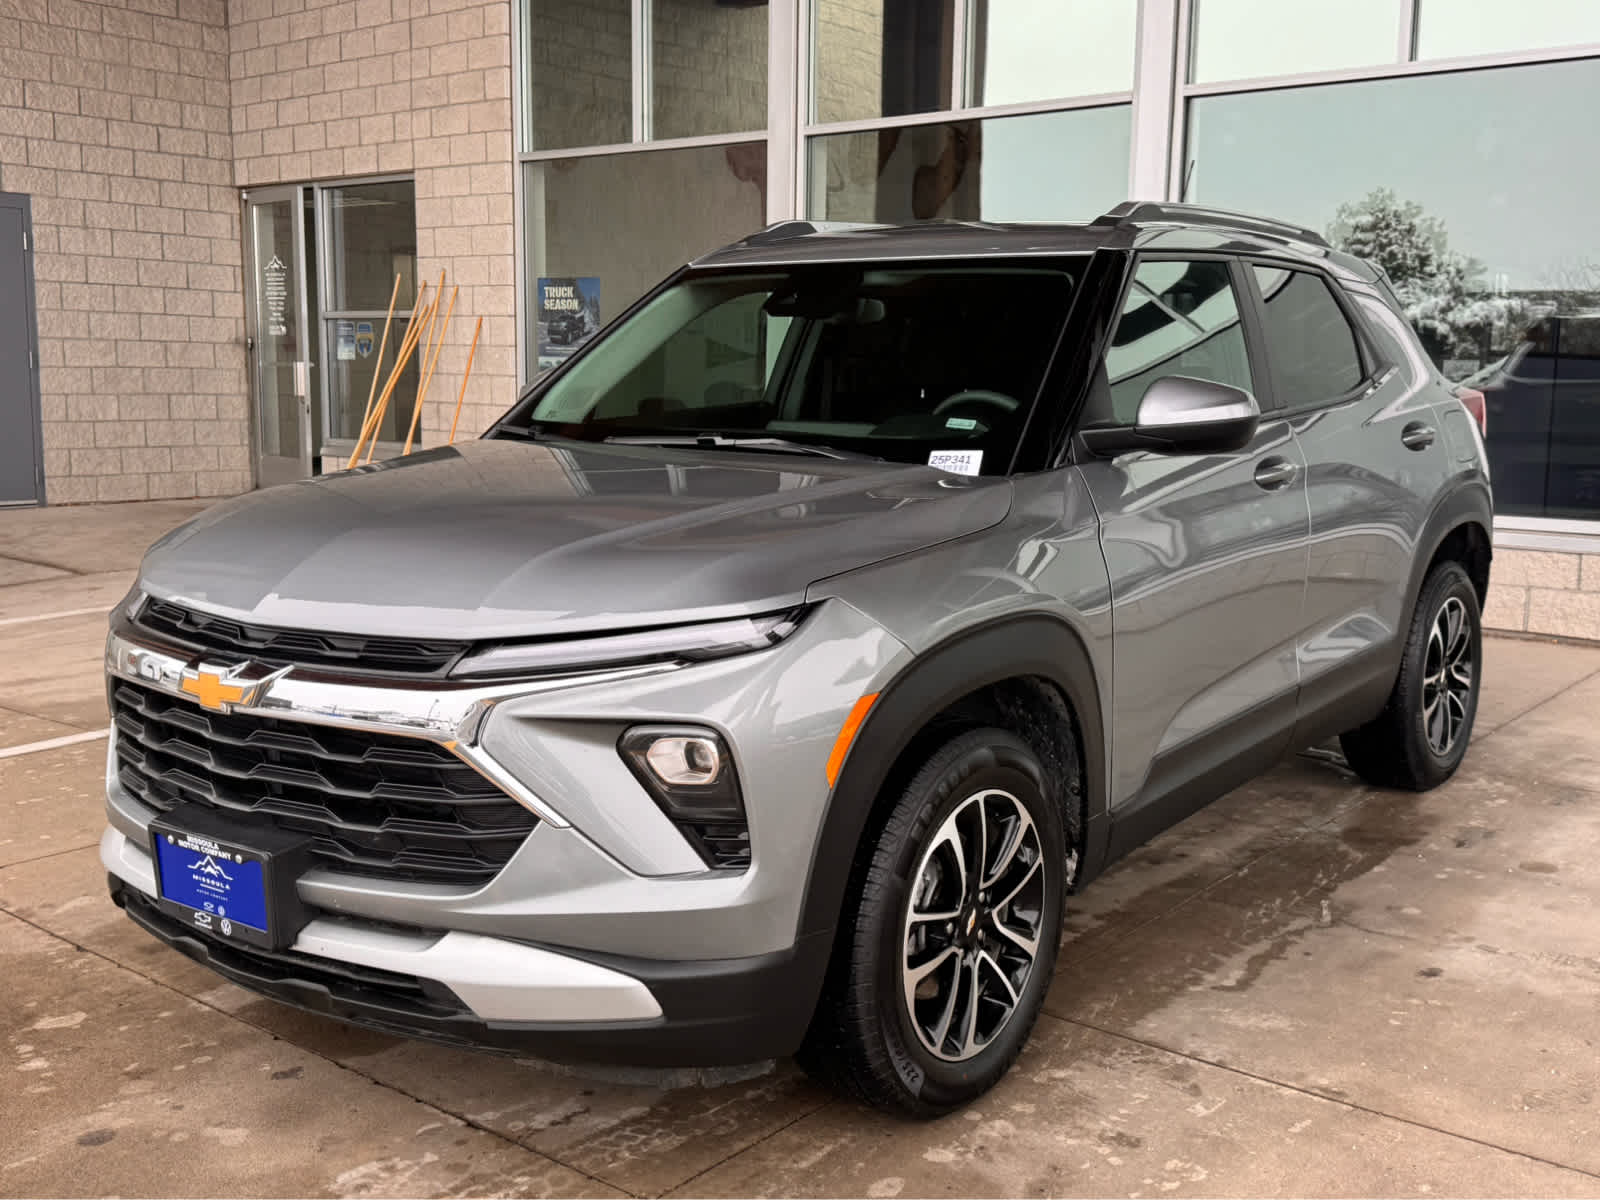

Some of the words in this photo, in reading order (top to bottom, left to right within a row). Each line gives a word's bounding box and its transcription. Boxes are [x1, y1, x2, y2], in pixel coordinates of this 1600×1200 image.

[543, 286, 574, 298] TRUCK
[543, 299, 579, 310] SEASON
[930, 455, 971, 465] 25P341
[178, 839, 201, 853] MOTOR
[193, 874, 230, 890] MISSOULA
